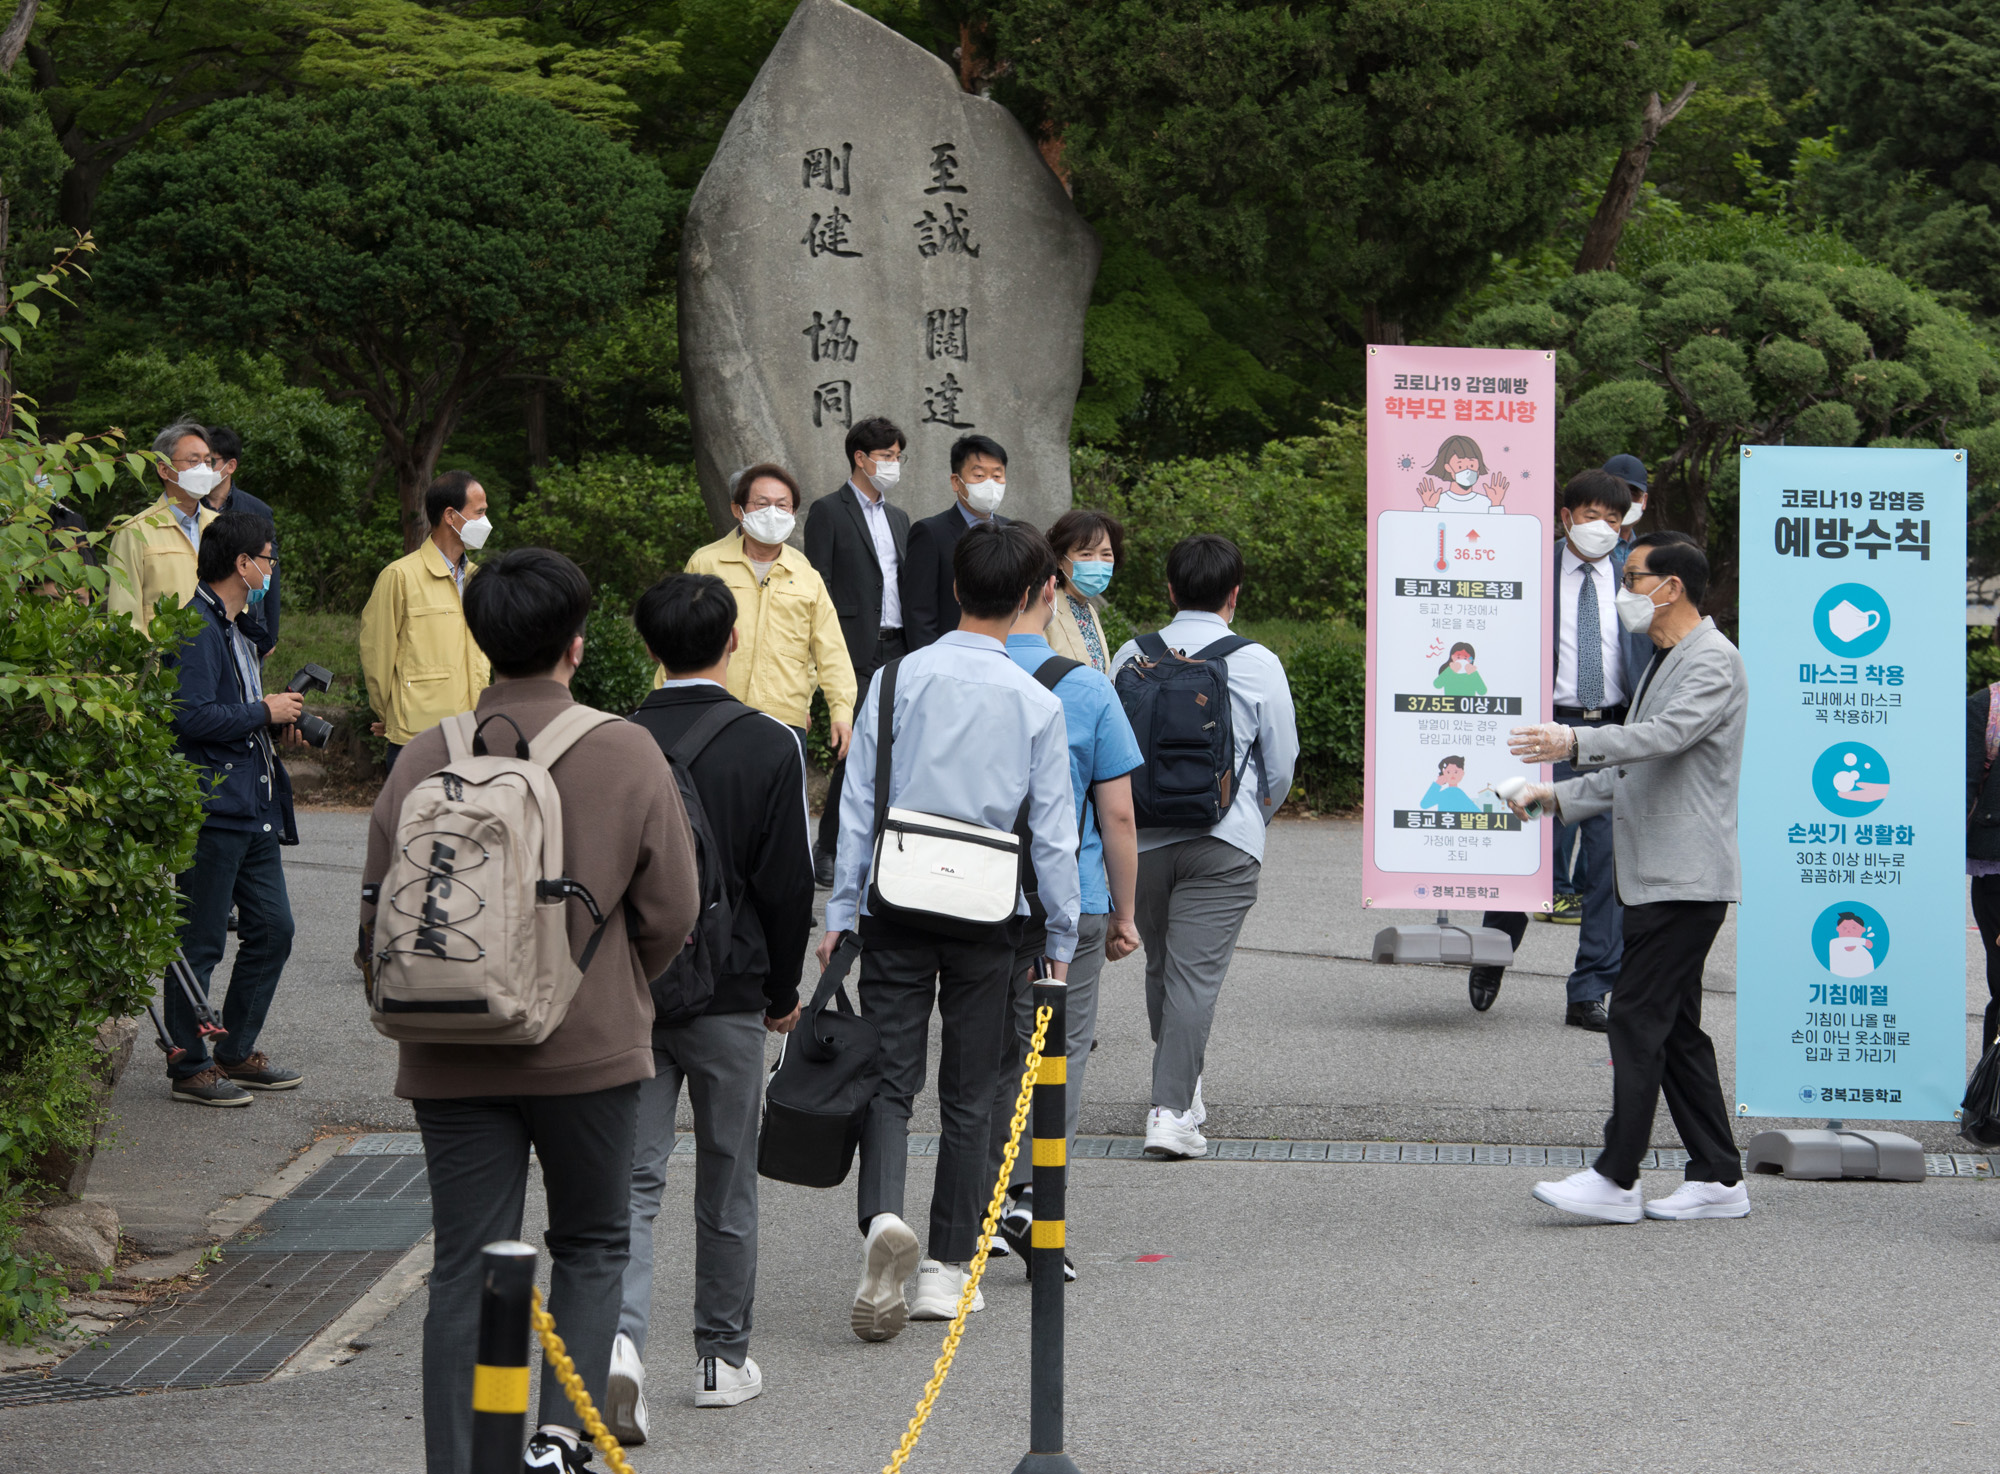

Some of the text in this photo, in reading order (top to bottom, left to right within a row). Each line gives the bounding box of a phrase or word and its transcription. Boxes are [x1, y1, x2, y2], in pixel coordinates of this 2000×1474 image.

[913, 142, 980, 258] 至誠
[801, 142, 863, 430] 剛健 協同
[1394, 374, 1528, 394] 코로나19 감염예방
[1385, 396, 1537, 423] 학부모 협조사항
[1782, 490, 1924, 511] 코로나19 감염증
[1775, 517, 1930, 560] 예방수칙
[1404, 581, 1513, 597] 등교 전 체온측정
[1420, 603, 1497, 616] 등교 전 가정에서
[1431, 618, 1485, 630] 체온을 측정
[1800, 664, 1904, 686] 마스크 착용
[1408, 698, 1507, 714] 37.5도 이상 시
[1802, 692, 1901, 707] 교내에서 마스크
[1816, 709, 1887, 724] 꼭 착용하기
[1419, 719, 1497, 732] 발열이 있는 경우
[1420, 733, 1496, 746] 담임교사에 연락
[1407, 813, 1507, 830] 등교 후 발열 시
[1424, 835, 1491, 847] 가정에 연락 후
[1788, 823, 1915, 846] 손씻기 생활화
[1448, 850, 1467, 861] 조퇴
[1797, 851, 1904, 867] 30초 이상 비누로
[1801, 869, 1900, 884] 꼼꼼하게 손씻기
[1432, 886, 1499, 898] 경복고등학교
[1810, 984, 1888, 1006] 기침예절
[1806, 1012, 1896, 1028] 기침이 나올 땐
[1792, 1030, 1910, 1046] 손이 아닌 옷소매로
[1806, 1047, 1895, 1063] 입과 코 가리기
[1821, 1088, 1901, 1103] 경복고등학교
